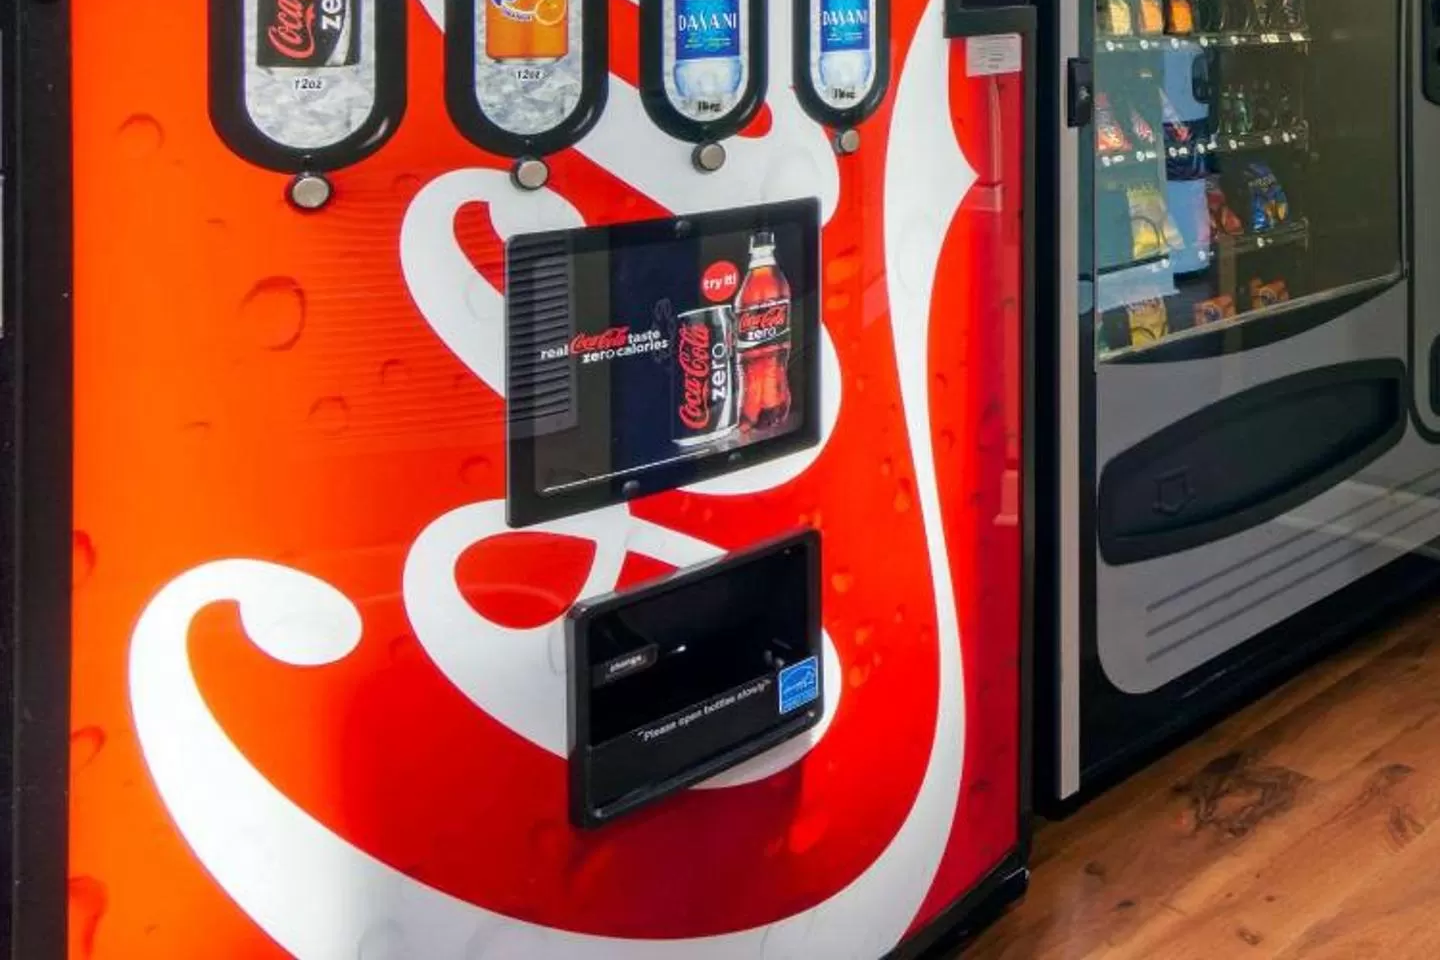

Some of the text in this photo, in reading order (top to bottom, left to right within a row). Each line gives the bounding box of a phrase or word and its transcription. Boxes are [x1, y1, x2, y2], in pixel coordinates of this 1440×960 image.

[516, 69, 541, 81] 12oz
[294, 78, 323, 90] 12oz
[703, 277, 722, 290] try
[747, 326, 777, 341] zero
[540, 344, 569, 360] real
[628, 330, 661, 344] taste
[581, 339, 669, 364] zero calories
[711, 343, 727, 402] zero
